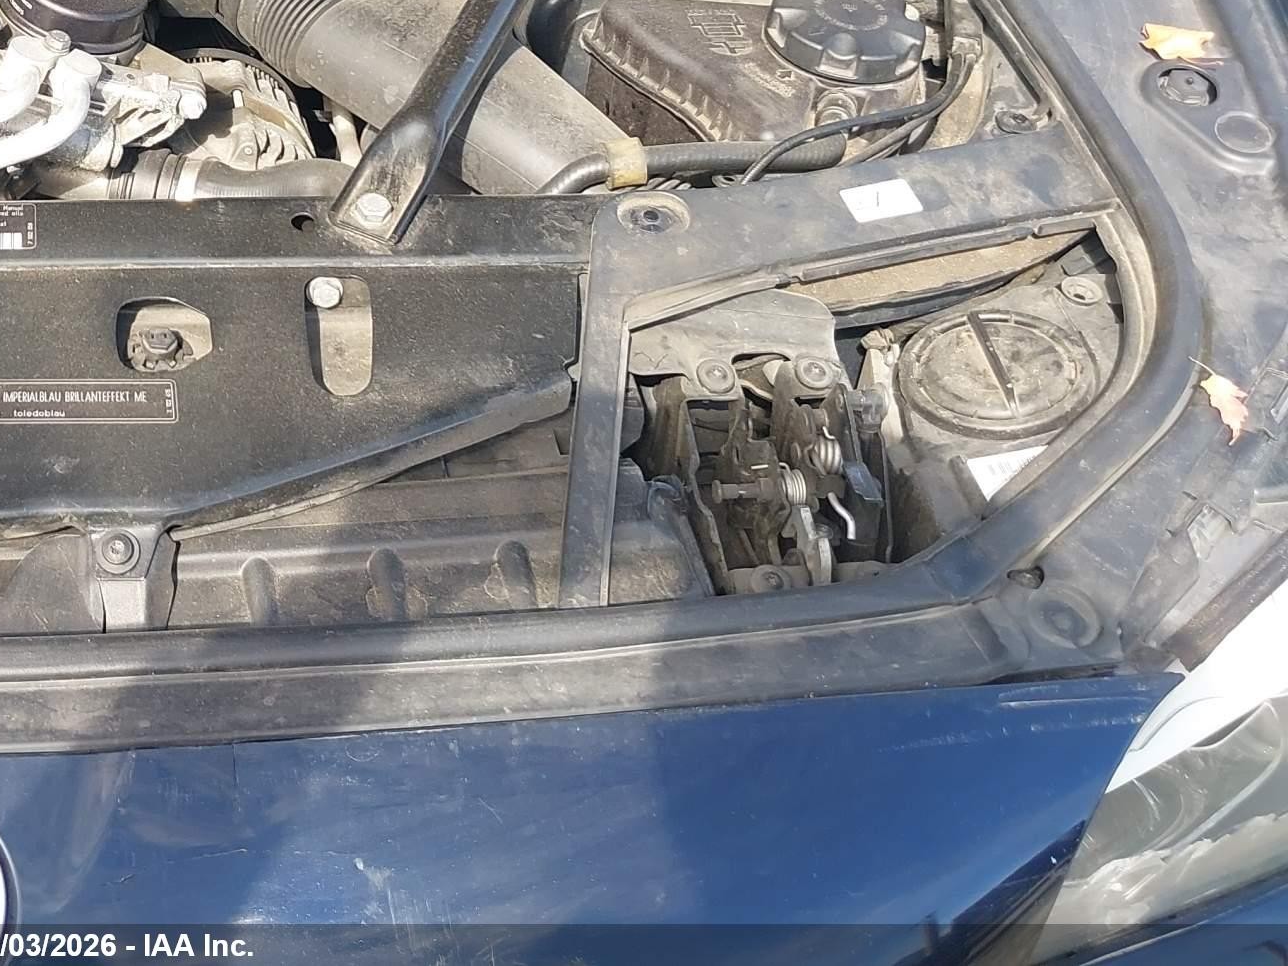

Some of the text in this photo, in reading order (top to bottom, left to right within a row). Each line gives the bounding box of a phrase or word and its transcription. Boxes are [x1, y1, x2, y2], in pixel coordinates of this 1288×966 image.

[2, 390, 148, 403] IMPERIALBLAU BRILLANTEFFEKT ME
[13, 409, 66, 418] toledoblau
